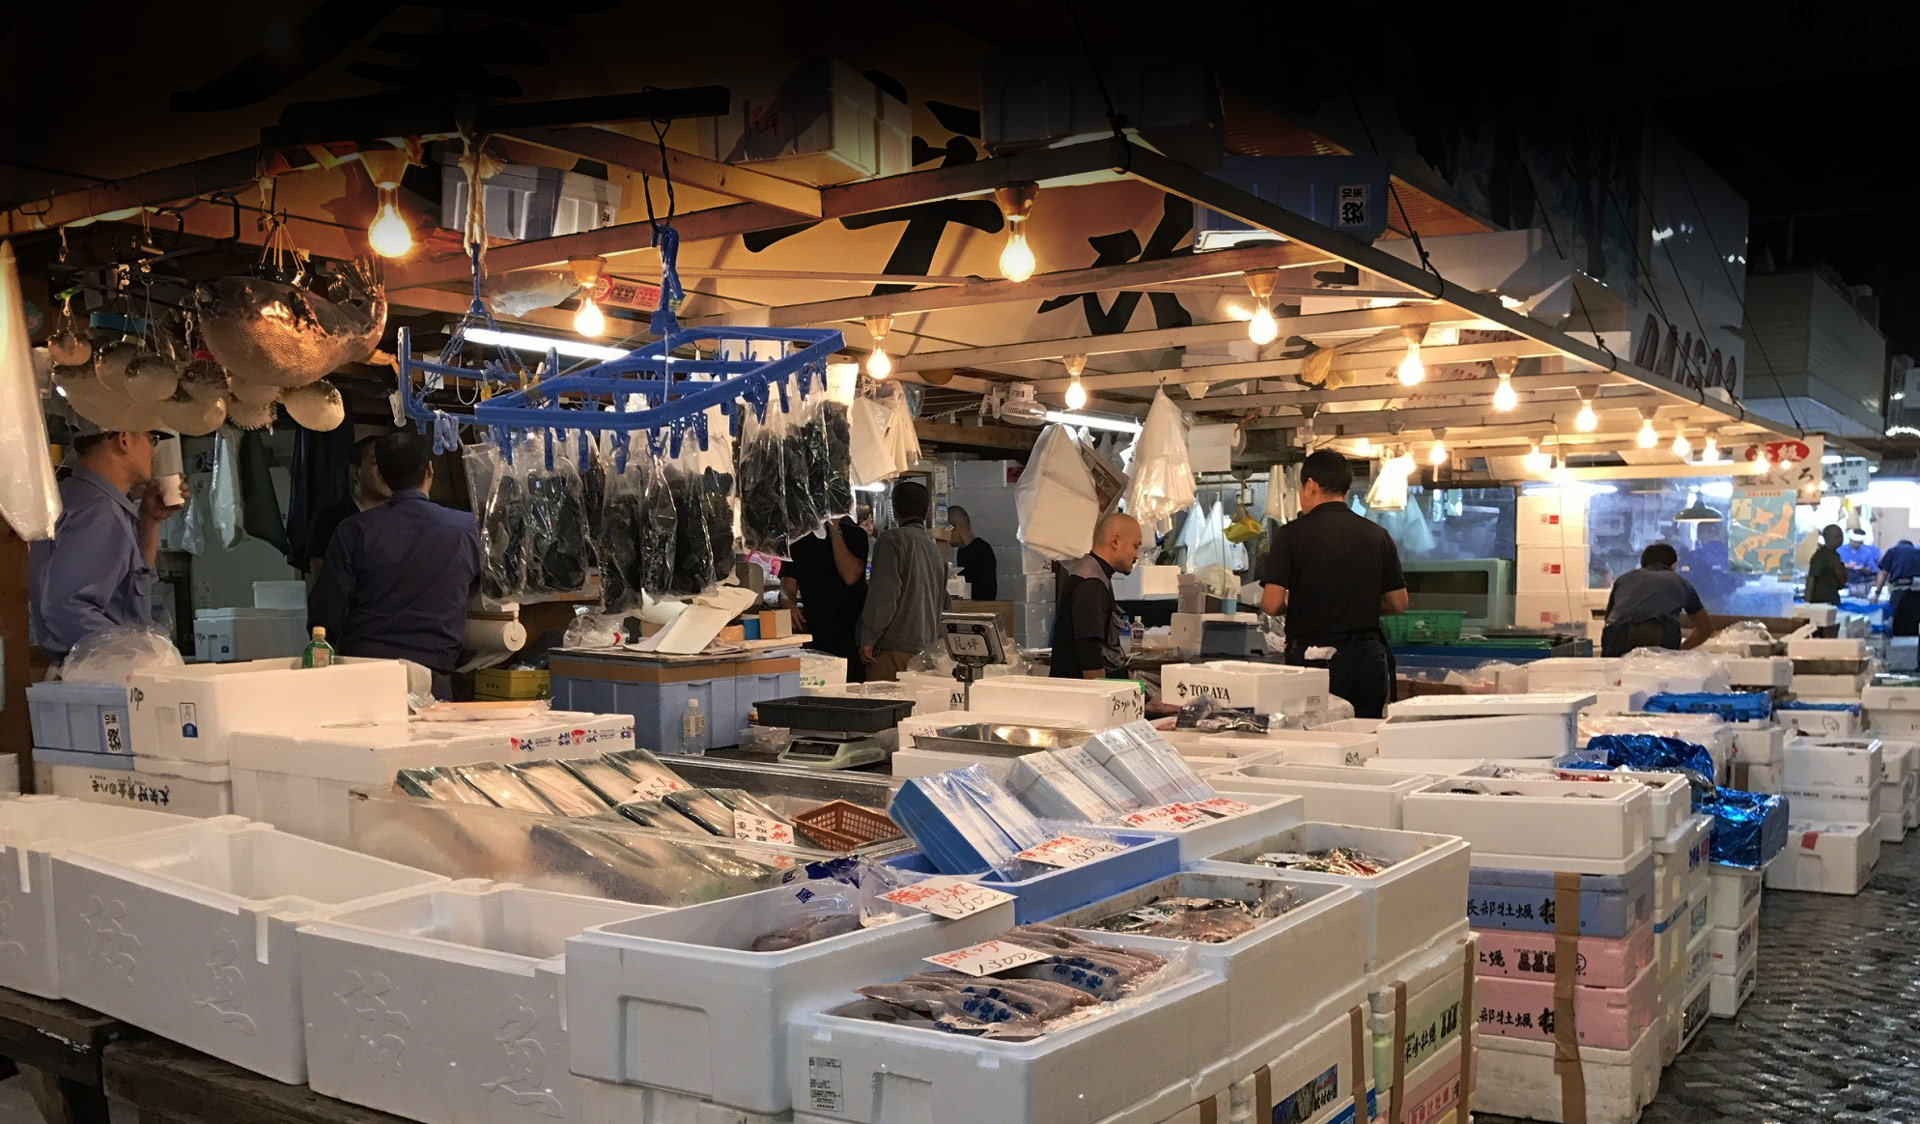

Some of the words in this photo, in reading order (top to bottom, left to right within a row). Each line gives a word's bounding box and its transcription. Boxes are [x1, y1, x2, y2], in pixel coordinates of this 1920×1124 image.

[1342, 201, 1364, 224] 袋
[950, 693, 965, 704] AY
[1478, 1007, 1534, 1030] 部牡蠣
